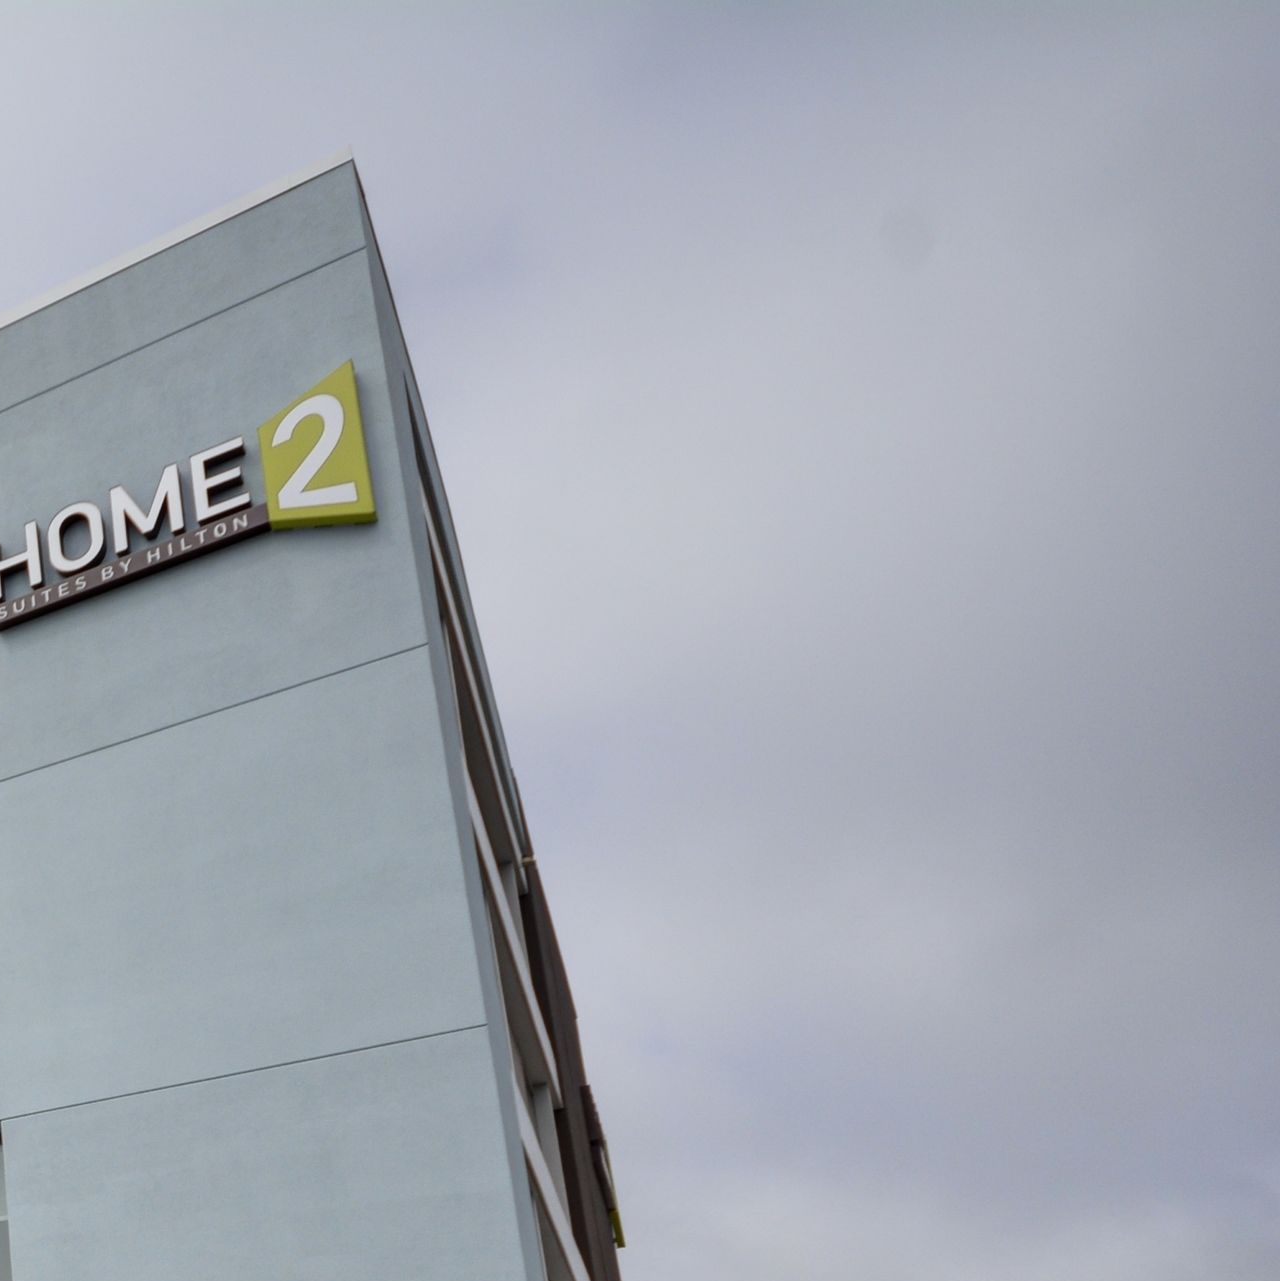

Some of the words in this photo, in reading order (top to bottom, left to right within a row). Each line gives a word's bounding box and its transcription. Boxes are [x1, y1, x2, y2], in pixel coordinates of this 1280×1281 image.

[271, 393, 358, 510] 2
[101, 558, 133, 582] BY
[146, 514, 249, 565] HILTON
